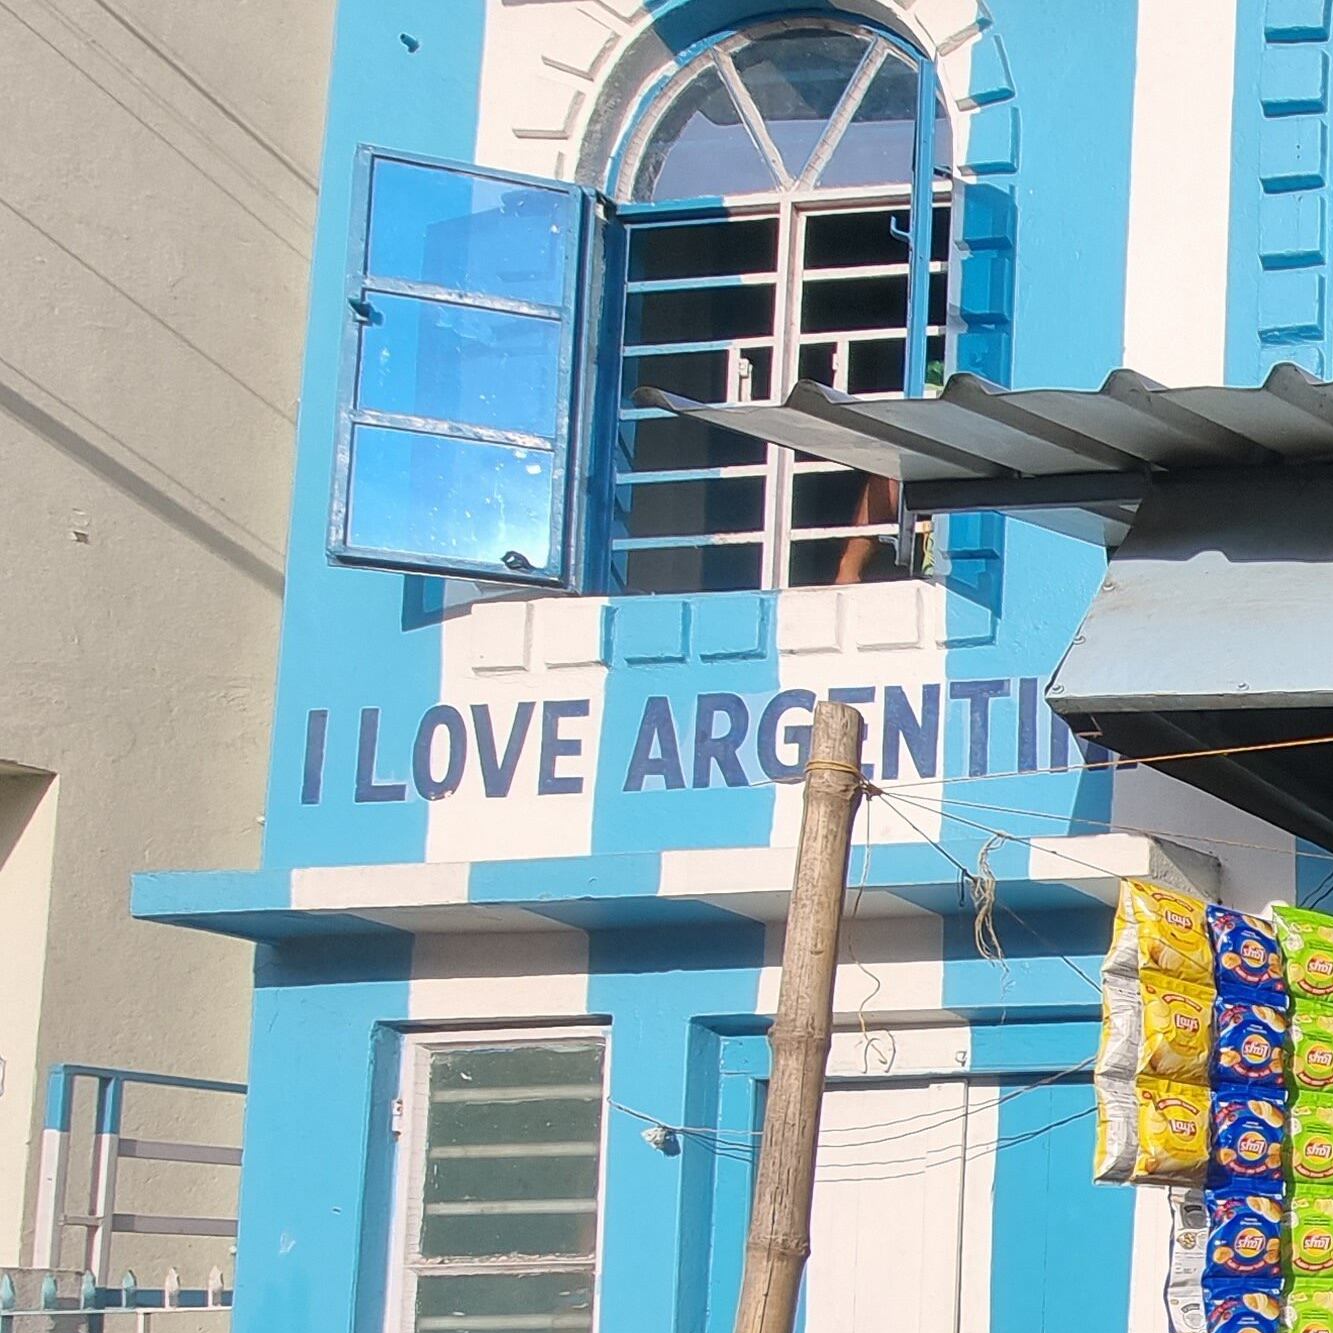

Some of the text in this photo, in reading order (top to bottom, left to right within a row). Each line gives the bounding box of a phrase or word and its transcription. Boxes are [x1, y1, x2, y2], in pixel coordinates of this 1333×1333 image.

[301, 677, 1138, 805] I LOVE ARGNTI
